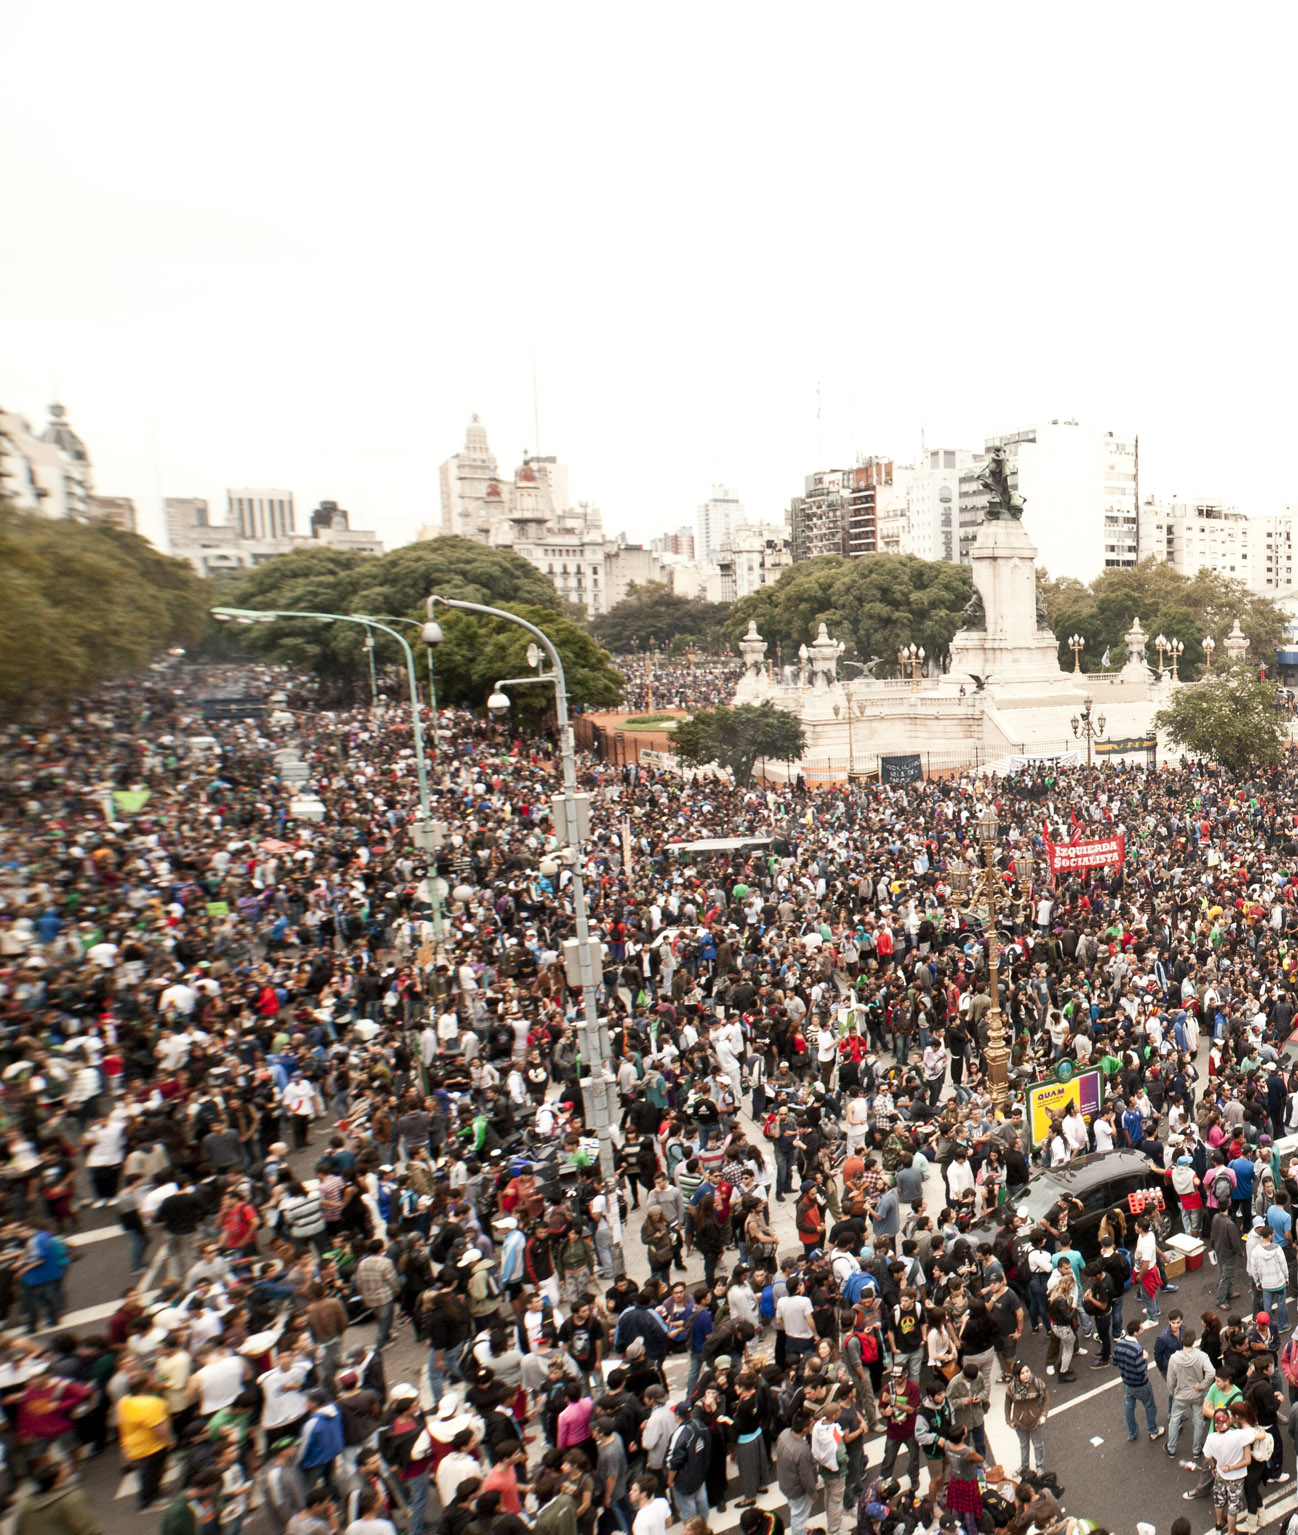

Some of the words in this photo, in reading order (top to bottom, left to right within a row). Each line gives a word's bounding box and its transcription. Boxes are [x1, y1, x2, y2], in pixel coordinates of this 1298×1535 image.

[941, 506, 952, 528] ibis
[1054, 841, 1117, 857] IZQUIERDA
[1054, 852, 1119, 869] SOCIALISTA
[1037, 1087, 1065, 1101] QUAM
